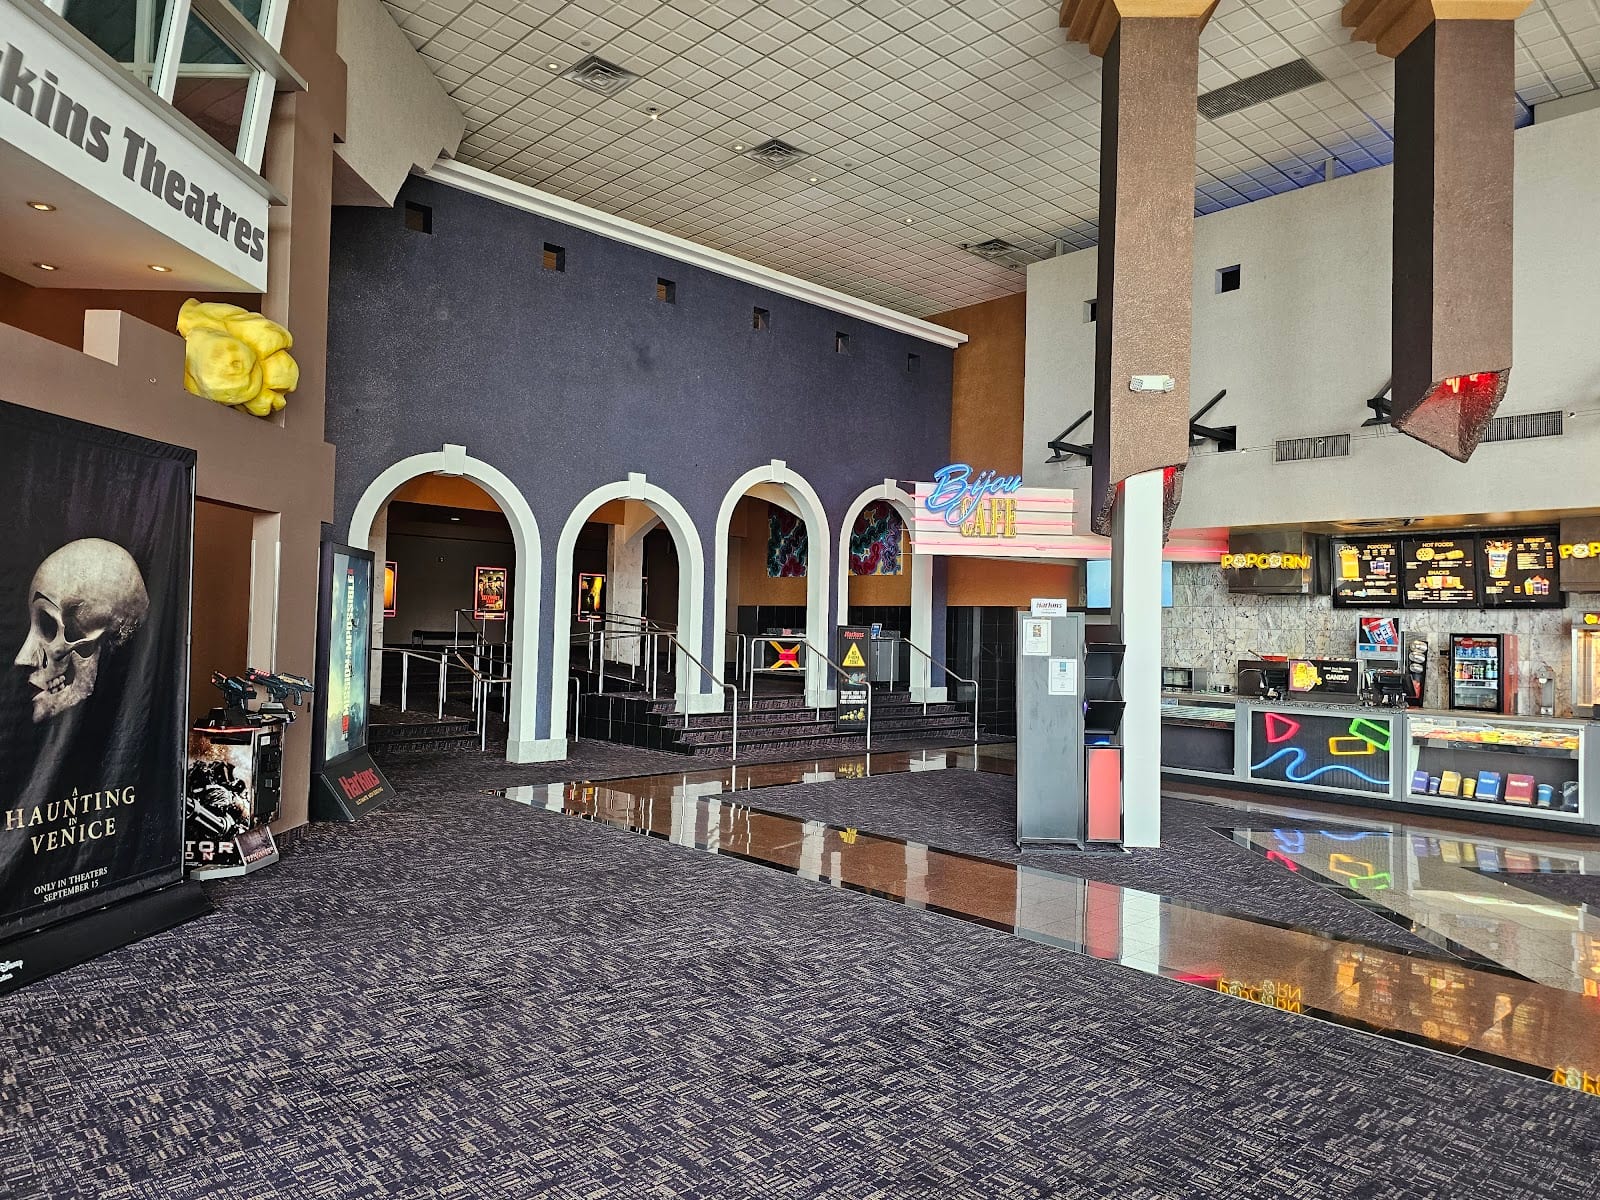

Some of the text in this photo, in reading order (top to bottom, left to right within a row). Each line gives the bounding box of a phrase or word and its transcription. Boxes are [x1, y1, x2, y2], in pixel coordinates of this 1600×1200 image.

[0, 41, 265, 263] kins Theatres
[925, 463, 1022, 527] Bijou
[960, 497, 1017, 538] CAFE
[1221, 553, 1312, 570] POPCORN
[71, 786, 78, 796] A
[338, 767, 380, 800] Harkins
[5, 785, 136, 831] HAUNTING
[68, 816, 78, 826] IN
[30, 817, 116, 855] VENICE
[33, 866, 108, 895] ONLY IN THEATERS
[43, 879, 99, 903] SEPTEMBER 15
